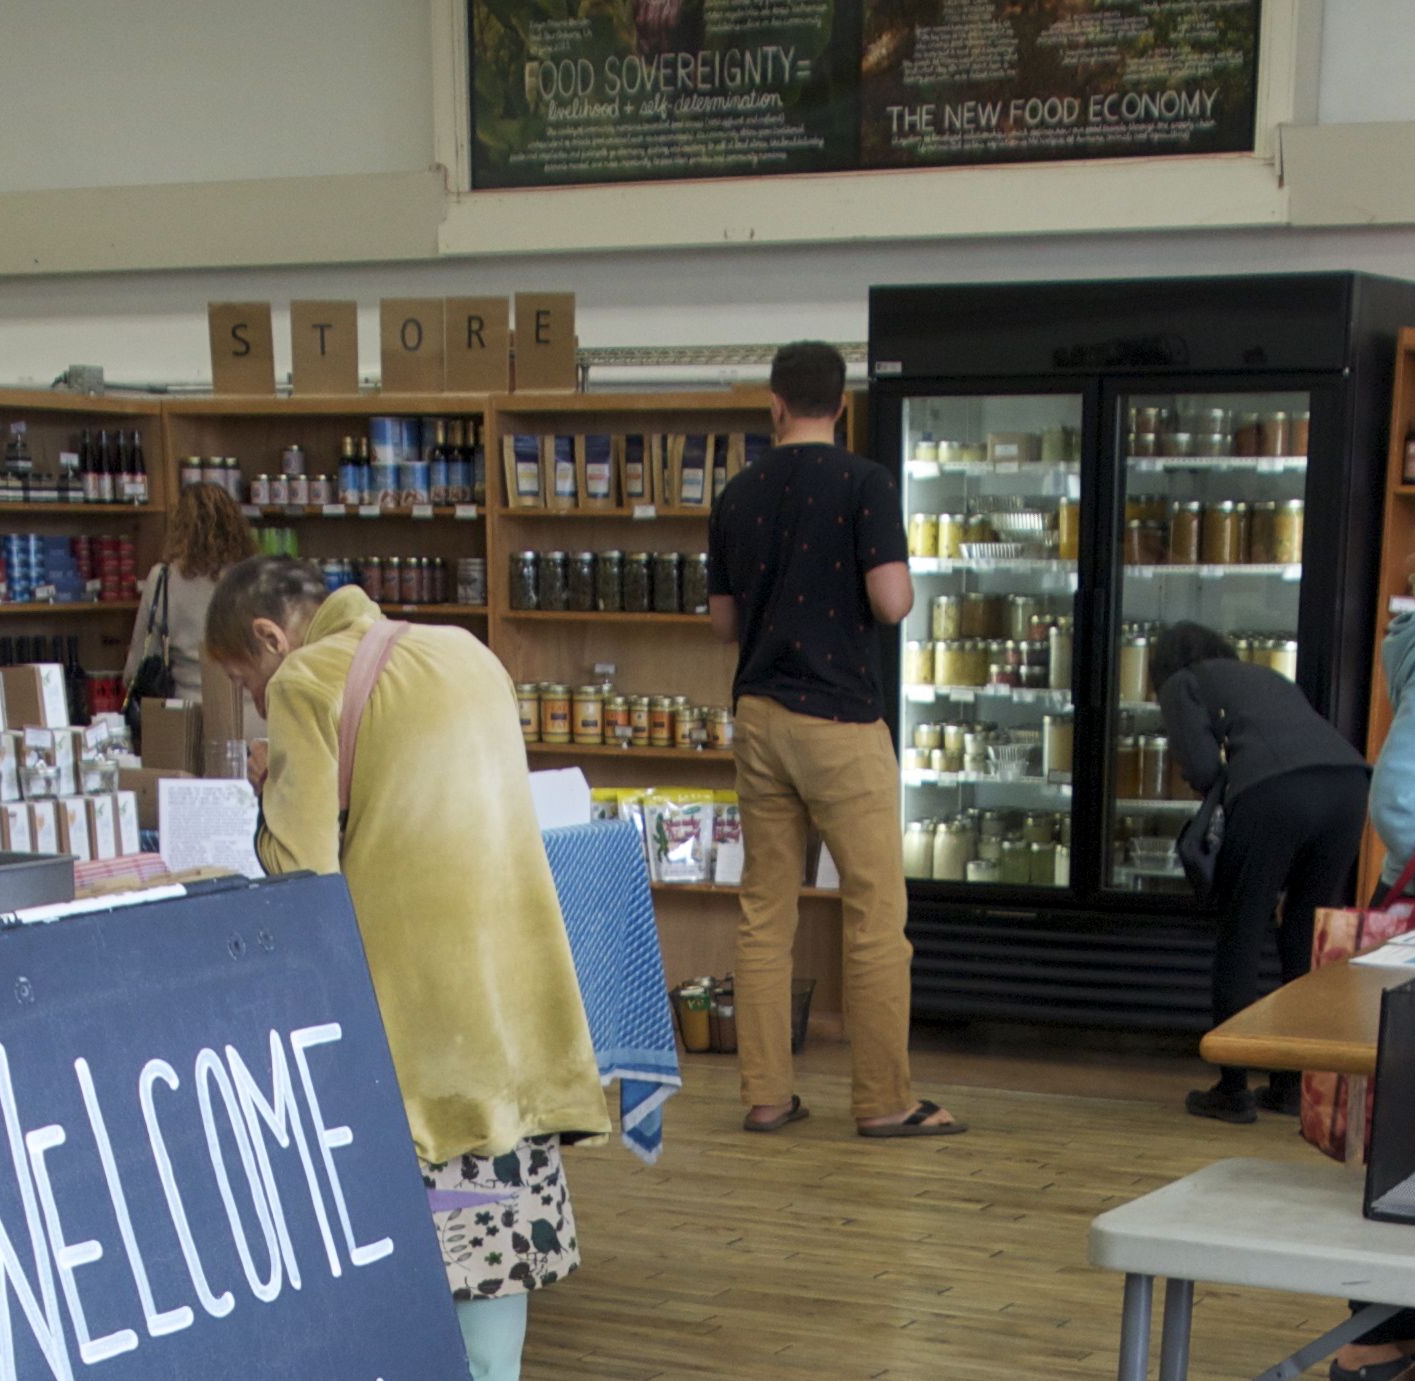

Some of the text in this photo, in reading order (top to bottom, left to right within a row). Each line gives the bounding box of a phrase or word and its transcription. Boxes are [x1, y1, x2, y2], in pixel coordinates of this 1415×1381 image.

[525, 58, 595, 100] FOOD
[547, 96, 620, 121] livelihood
[639, 90, 784, 120] self-determination
[886, 87, 1220, 133] THE NEW FOOD ECONOMY
